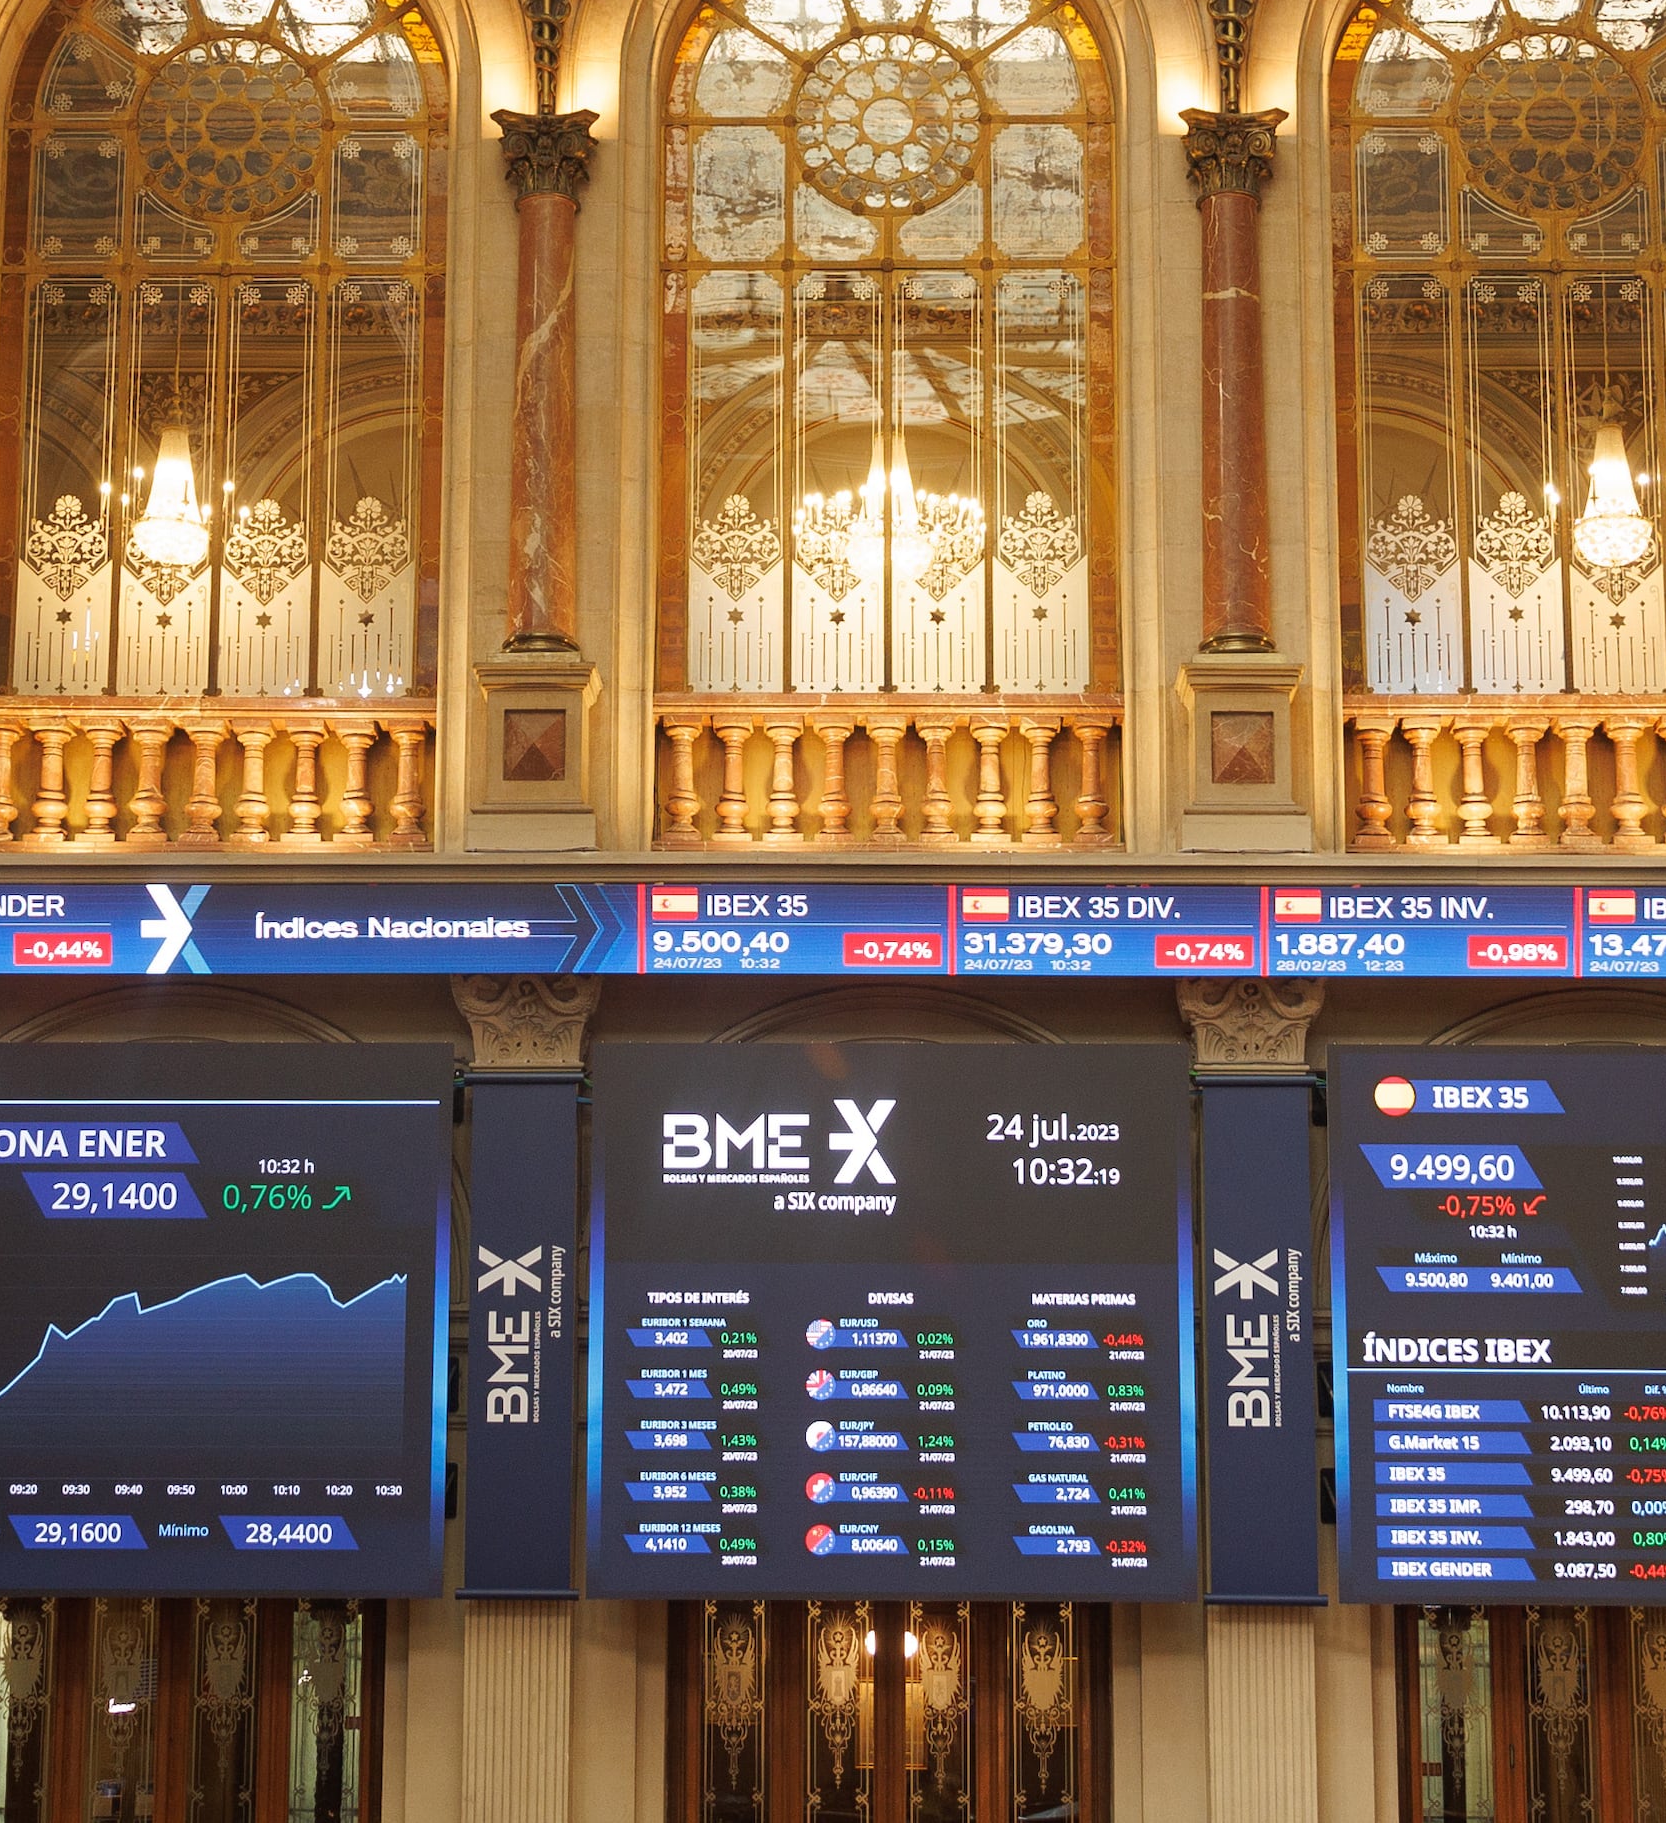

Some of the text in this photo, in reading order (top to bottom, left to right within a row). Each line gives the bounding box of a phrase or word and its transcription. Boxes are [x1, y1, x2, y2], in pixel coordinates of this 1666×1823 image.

[707, 895, 808, 920] IBEX 35
[1018, 896, 1180, 918] IBEX 35 DIV.
[1330, 897, 1493, 919] IBEX 35 INV.
[255, 911, 530, 938] Índices Nacionales
[24, 941, 102, 961] -0,44%
[653, 931, 789, 956] 9.500,40
[854, 942, 932, 961] -0,74%
[964, 933, 1112, 958] 31.379,30
[1166, 943, 1244, 963] -0,74%
[1276, 934, 1404, 959] 1.887,40
[1478, 944, 1558, 963] -0,98%
[654, 957, 780, 968] 24/07/23 10:32
[1433, 1087, 1528, 1108] IBEX 35
[663, 1114, 809, 1169] BME
[987, 1113, 1119, 1148] 24 jul.2023
[79, 1130, 166, 1157] ENER
[259, 1159, 300, 1173] 10:32
[1013, 1158, 1120, 1185] 10:32:19
[1391, 1154, 1514, 1184] 9.499,60
[52, 1183, 311, 1213] 29,1400 0,76%
[774, 1192, 896, 1215] a SIX company
[1438, 1195, 1516, 1218] -0,75%
[548, 1244, 566, 1339] a SIX company
[647, 1290, 749, 1304] TIPOS DE INTERÉS
[868, 1293, 914, 1304] DIVISAS
[1032, 1294, 1136, 1305] MATERIAS PRIMAS
[1285, 1247, 1303, 1342] a SIX company
[1363, 1332, 1551, 1363] ÍNDICES IBEX
[486, 1310, 530, 1423] BME
[1225, 1314, 1271, 1427] BME
[1389, 1404, 1442, 1419] FTSE4G
[1445, 1405, 1480, 1419] IBEX
[1541, 1405, 1611, 1421] 10.113,90
[35, 1523, 121, 1545] 29,1600
[159, 1524, 332, 1546] Mínimo 28,4400
